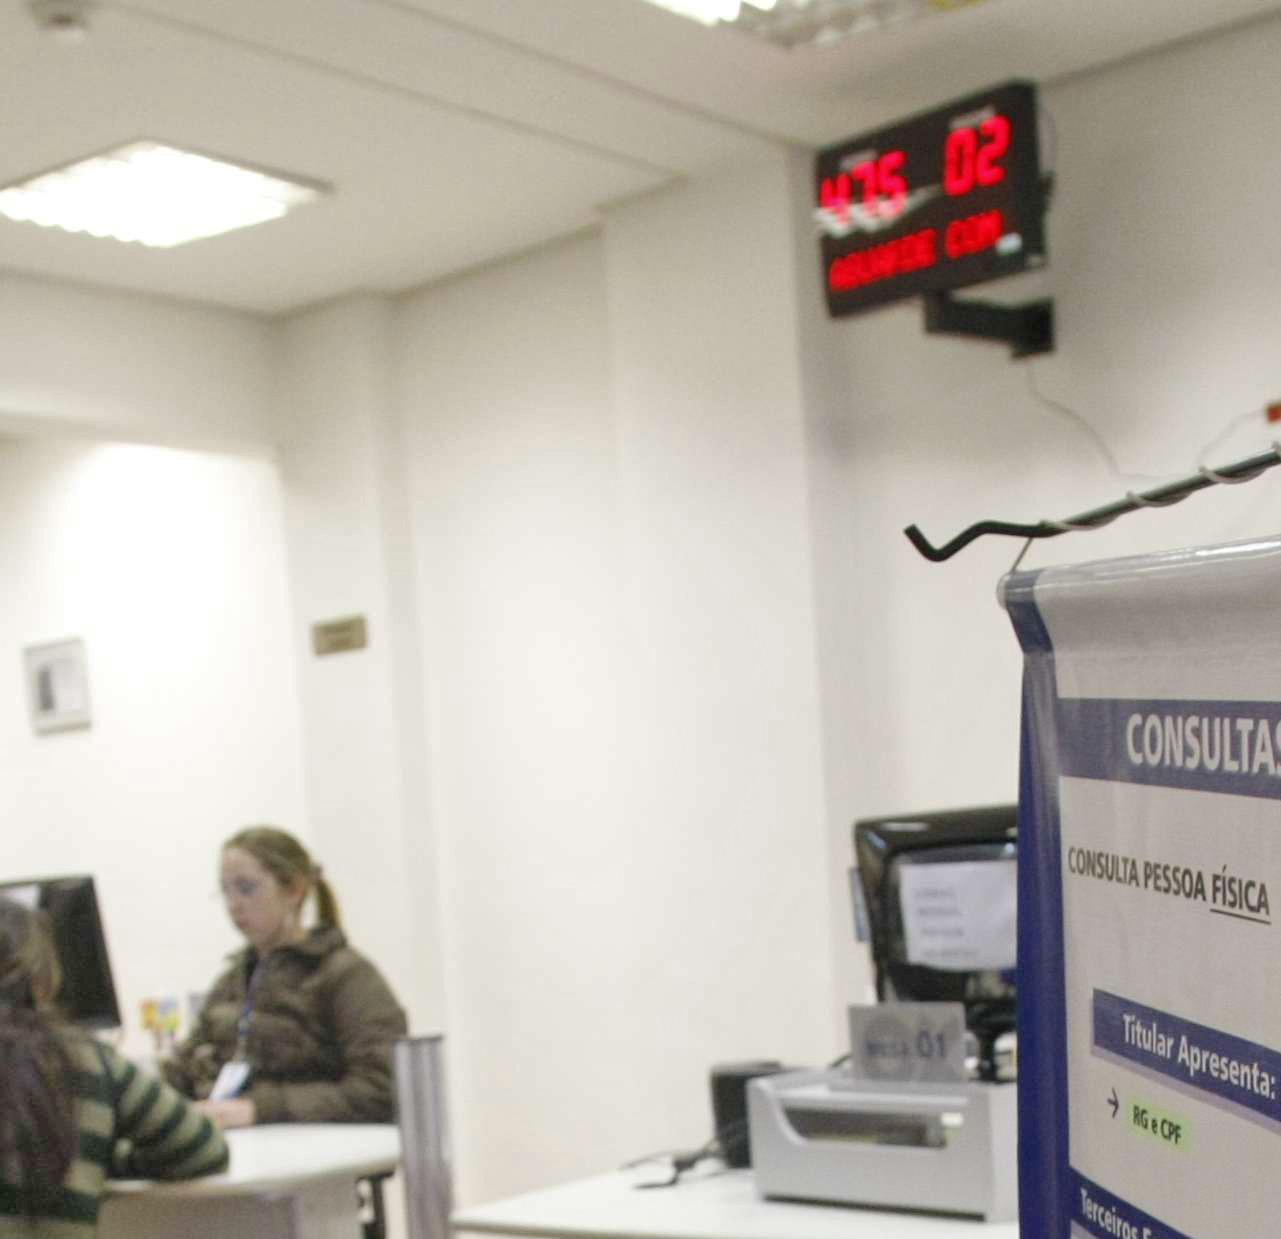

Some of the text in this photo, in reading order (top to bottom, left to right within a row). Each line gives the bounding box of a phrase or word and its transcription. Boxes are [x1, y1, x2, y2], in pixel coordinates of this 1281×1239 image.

[819, 115, 1011, 227] 475 02
[1068, 846, 1270, 916] CONSULTA PESSOA FÍSICA
[1123, 1014, 1276, 1101] Titular Apresenta:
[1133, 1105, 1182, 1145] RG e CPF
